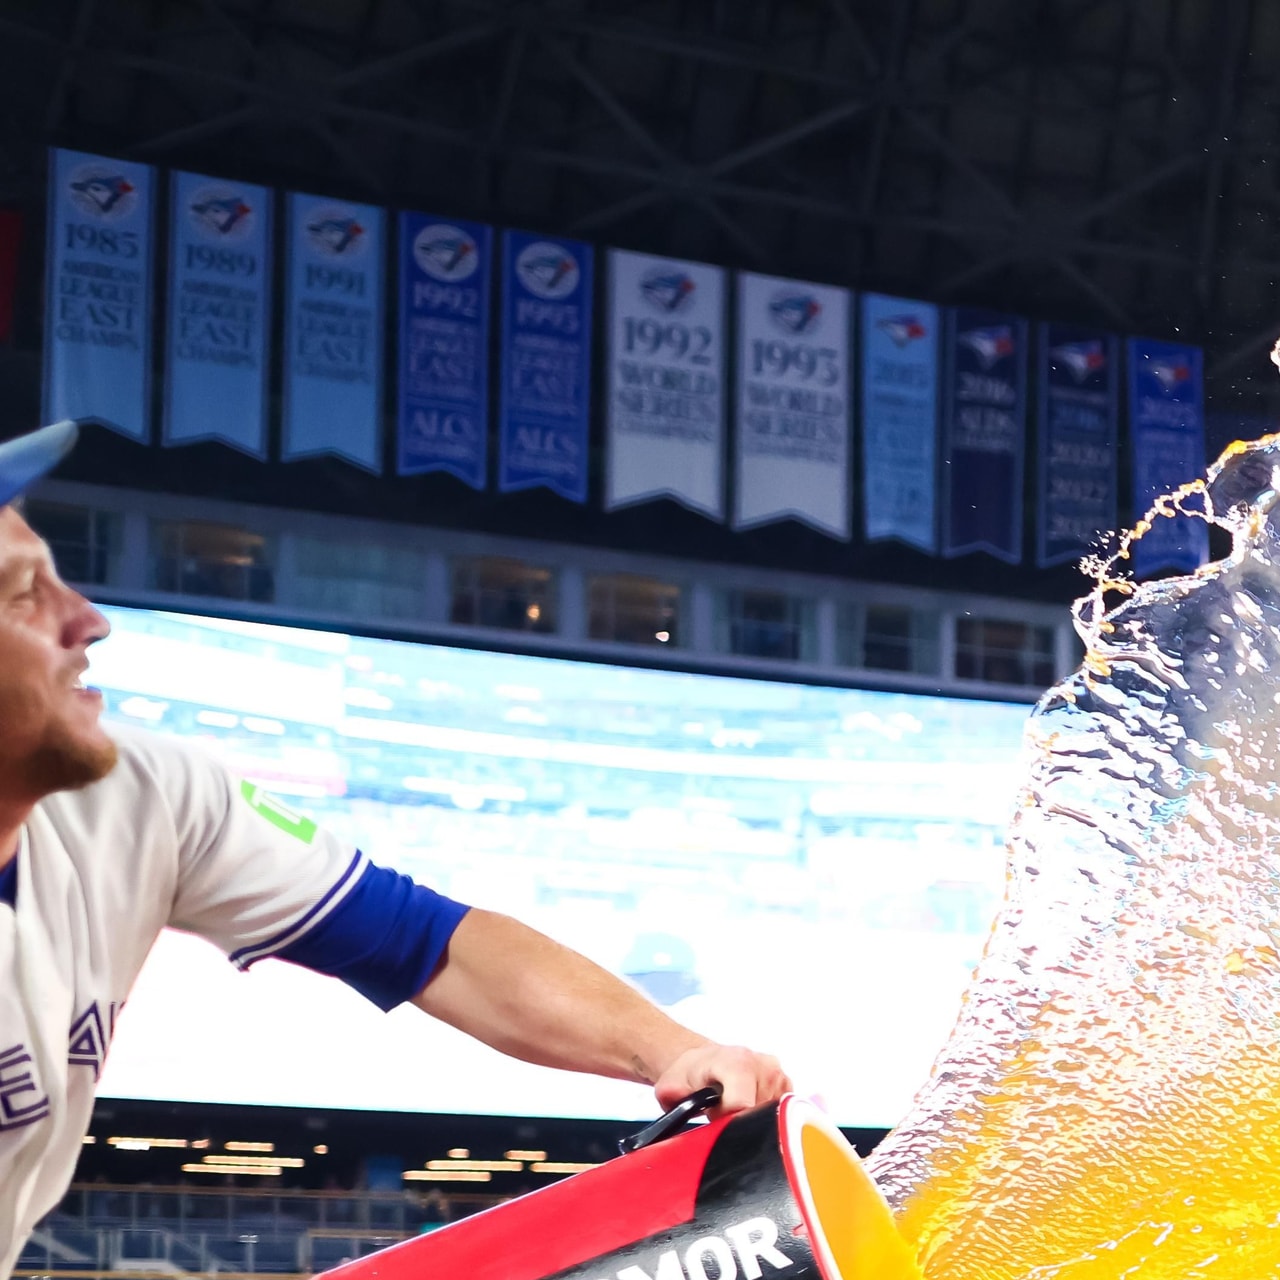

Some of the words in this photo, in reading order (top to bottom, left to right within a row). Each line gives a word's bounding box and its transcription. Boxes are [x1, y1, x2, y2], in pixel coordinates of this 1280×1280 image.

[64, 223, 139, 259] 1985
[184, 243, 256, 276] 1989
[306, 262, 366, 297] 1991
[59, 297, 136, 332] EAST
[413, 281, 479, 318] 1992
[622, 315, 712, 366] 1992
[618, 359, 717, 395] WORLD
[751, 338, 839, 386] 1993
